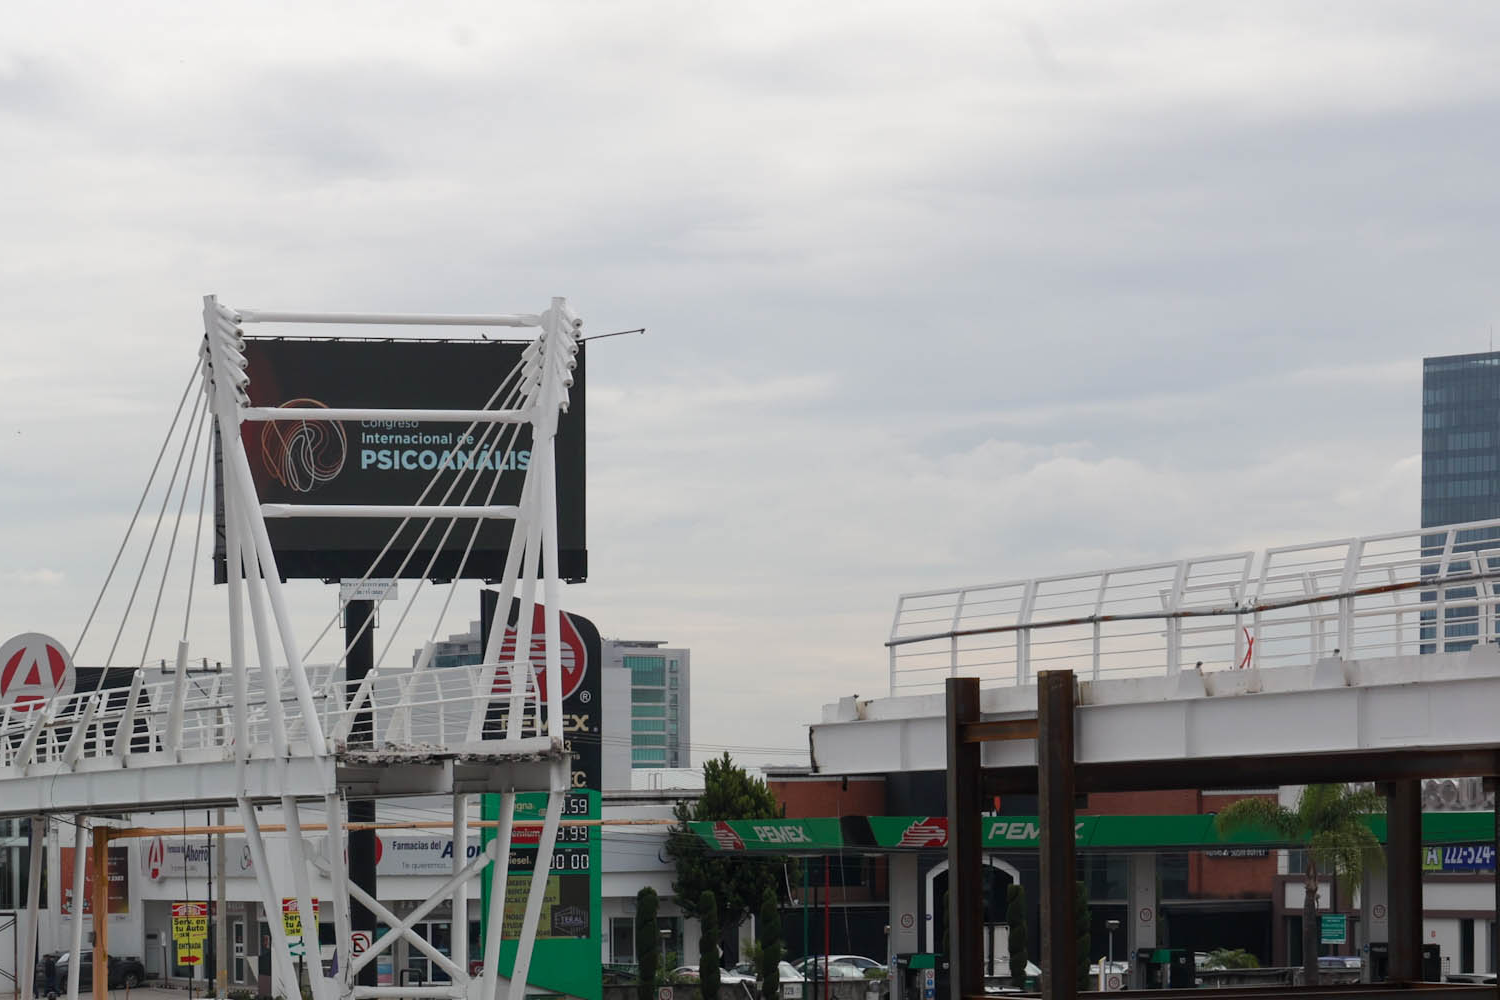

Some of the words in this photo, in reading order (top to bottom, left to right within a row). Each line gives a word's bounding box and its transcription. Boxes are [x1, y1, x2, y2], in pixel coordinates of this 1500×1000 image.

[361, 432, 452, 444] Internacional
[457, 432, 475, 444] de
[752, 825, 813, 843] PEMEX
[988, 822, 1085, 840] PEM
[392, 841, 429, 850] Farmacias
[430, 839, 441, 850] del
